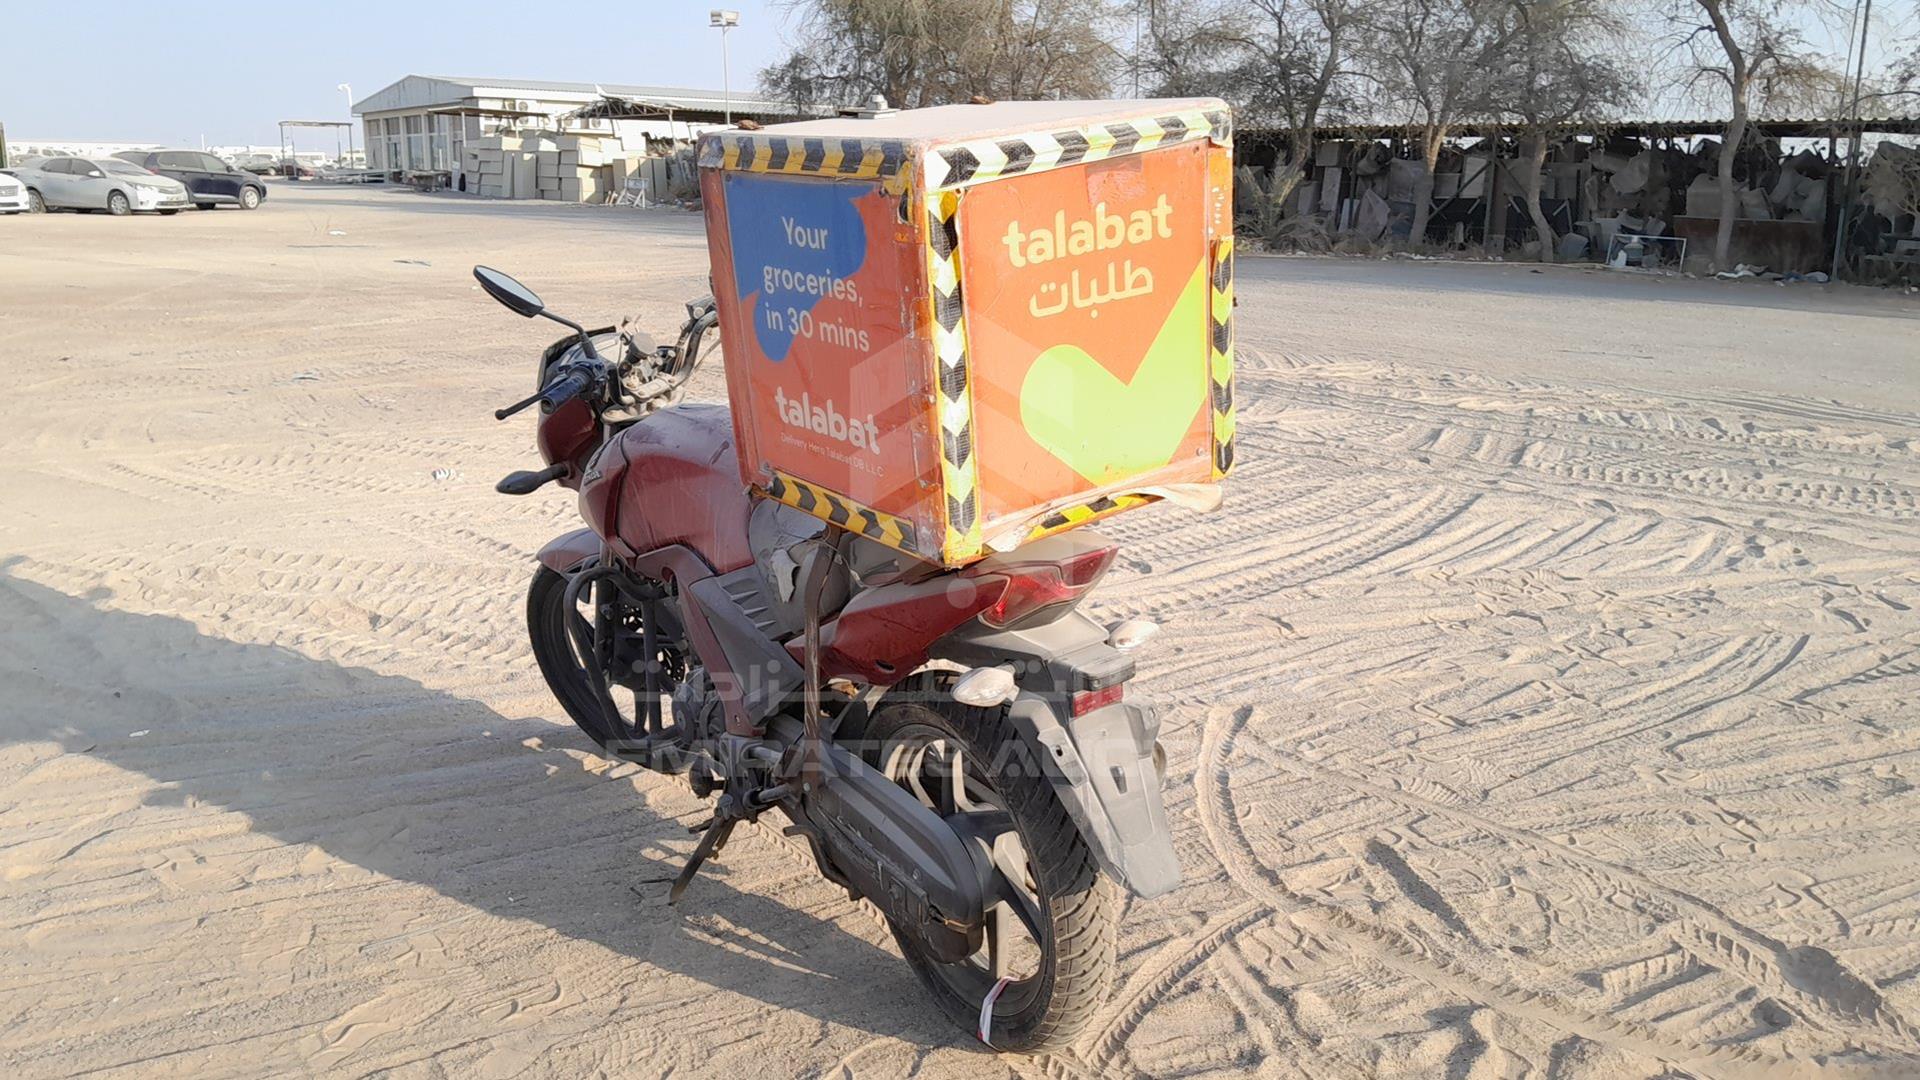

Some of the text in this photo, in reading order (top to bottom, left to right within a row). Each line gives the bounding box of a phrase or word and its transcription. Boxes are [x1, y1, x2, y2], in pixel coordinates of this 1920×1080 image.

[781, 216, 829, 250] Your
[1002, 194, 1173, 268] talabat
[763, 265, 863, 307] groceries,
[1029, 259, 1154, 318] طلبات
[765, 303, 870, 352] in 30 mins
[775, 386, 881, 455] talabat
